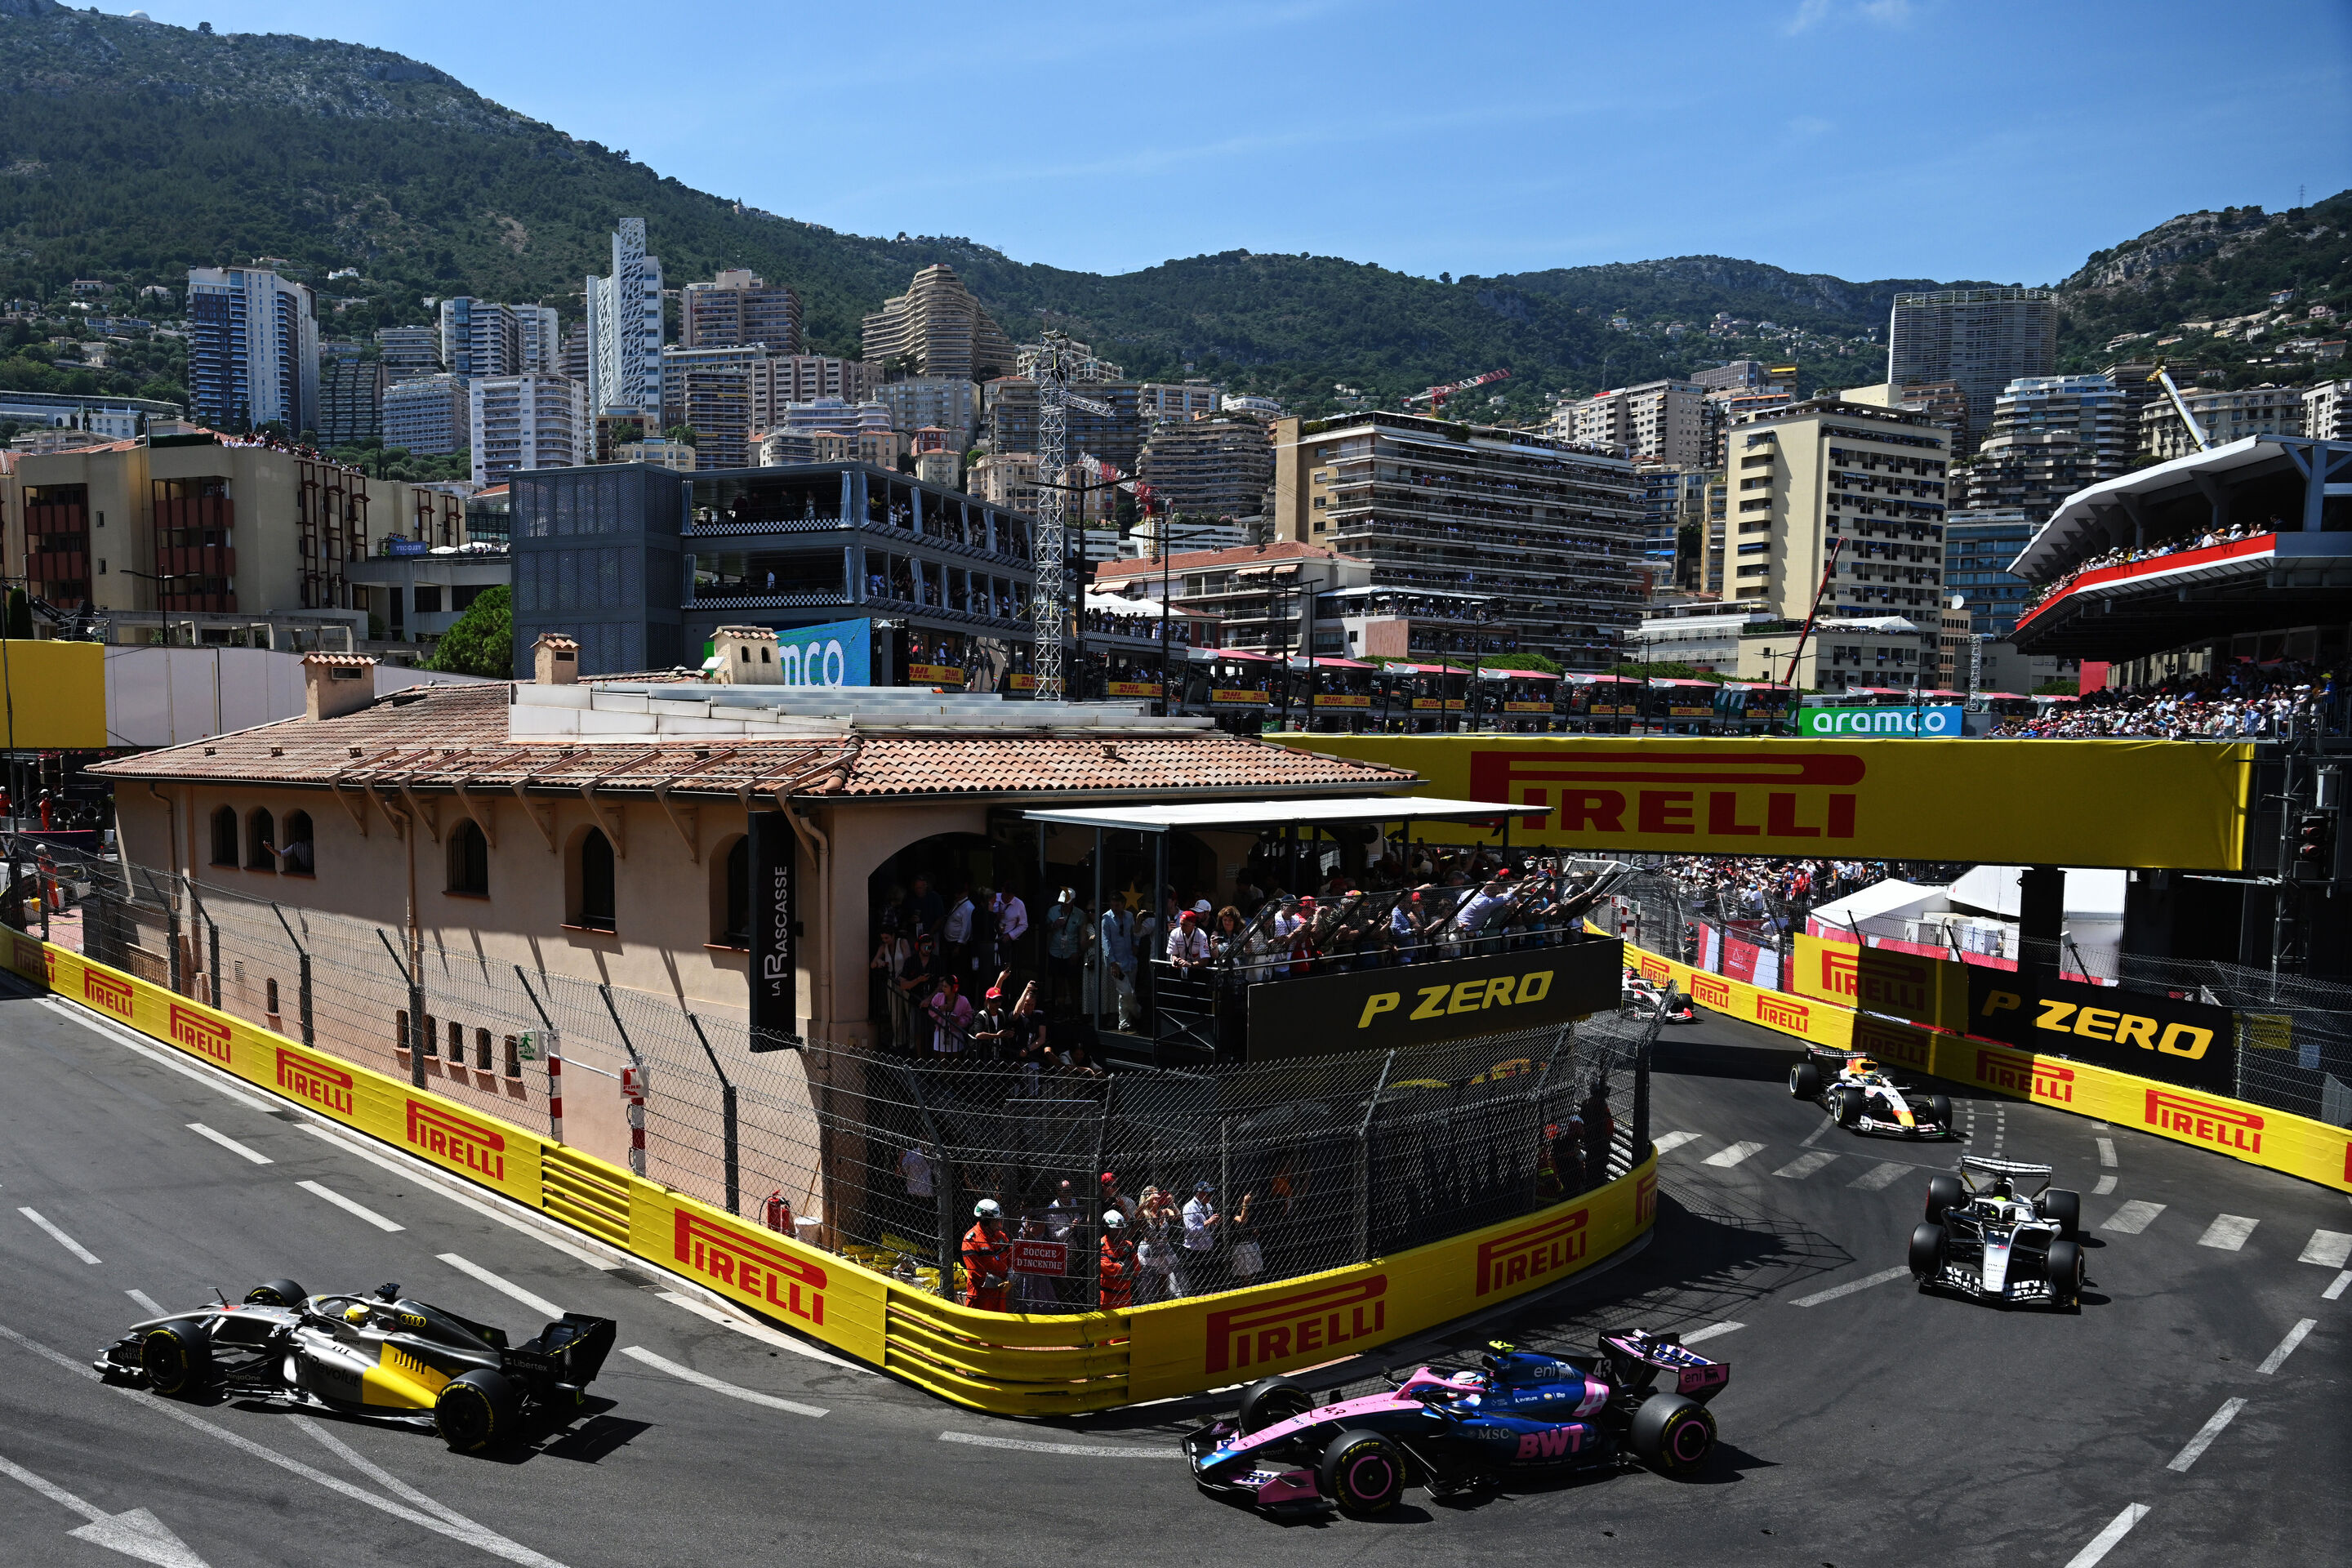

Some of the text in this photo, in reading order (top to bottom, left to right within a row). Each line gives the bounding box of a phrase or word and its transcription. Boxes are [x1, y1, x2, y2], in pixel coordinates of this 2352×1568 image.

[1116, 684, 1142, 693] DHL
[1219, 691, 1243, 700] DHL
[1813, 711, 1946, 733] aramco
[1470, 751, 1866, 838] PIRELLI
[764, 866, 787, 996] LA RASCASSE
[13, 939, 55, 983] PIRELLI
[84, 967, 133, 1018] PIRELLI
[1357, 970, 1553, 1028] P ZERO
[1690, 974, 1730, 1009] PIRELLI
[1822, 950, 1927, 1012] PIRELLI
[1757, 994, 1810, 1033] PIRELLI
[1981, 990, 2020, 1017] P
[2032, 999, 2214, 1061] ZERO
[170, 1004, 231, 1063] PIRELLI
[276, 1048, 353, 1116] PIRELLI
[1976, 1049, 2075, 1103] PIRELLI
[407, 1098, 505, 1181] PIRELLI
[2145, 1089, 2264, 1154] PIRELLI
[675, 1211, 826, 1326] PIRELLI
[1023, 1248, 1057, 1258] BOUCHE
[1477, 1209, 1588, 1297] PIRELLI
[339, 1336, 361, 1346] Castrol
[1205, 1274, 1388, 1374] PIRELLI
[225, 1372, 261, 1382] ninjaOne
[310, 1355, 359, 1387] Revolut
[513, 1358, 548, 1372] Libertex
[1534, 1361, 1556, 1378] eni
[1592, 1359, 1612, 1378] 43
[1684, 1370, 1702, 1383] eni
[1323, 1407, 1346, 1415] 43
[1477, 1428, 1510, 1441] MSC
[1515, 1423, 1585, 1459] BWT
